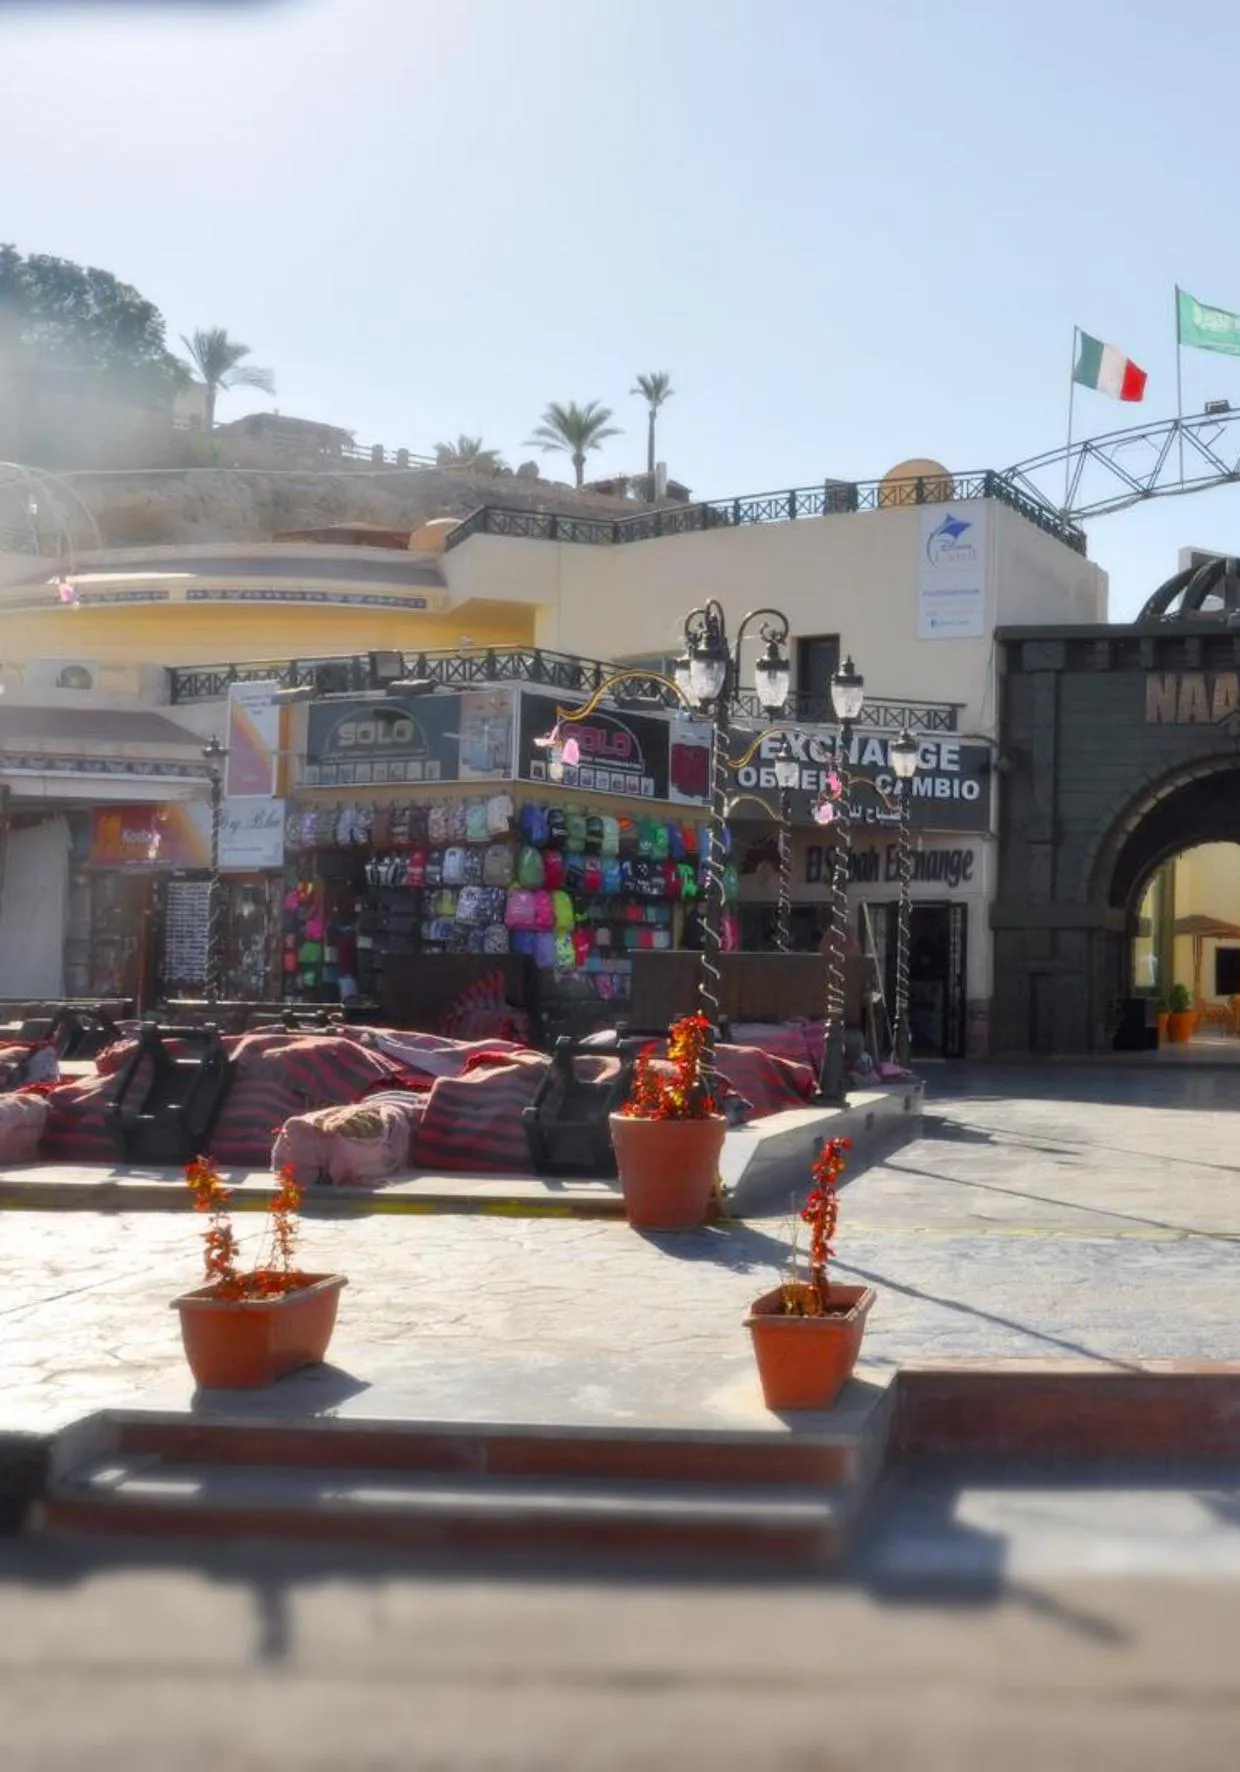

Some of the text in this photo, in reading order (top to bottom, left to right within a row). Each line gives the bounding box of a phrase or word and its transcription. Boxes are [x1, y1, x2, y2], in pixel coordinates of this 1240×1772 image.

[338, 719, 413, 746] SOLO
[760, 734, 961, 771] EXCHAGE
[738, 766, 839, 790] ОБЕ
